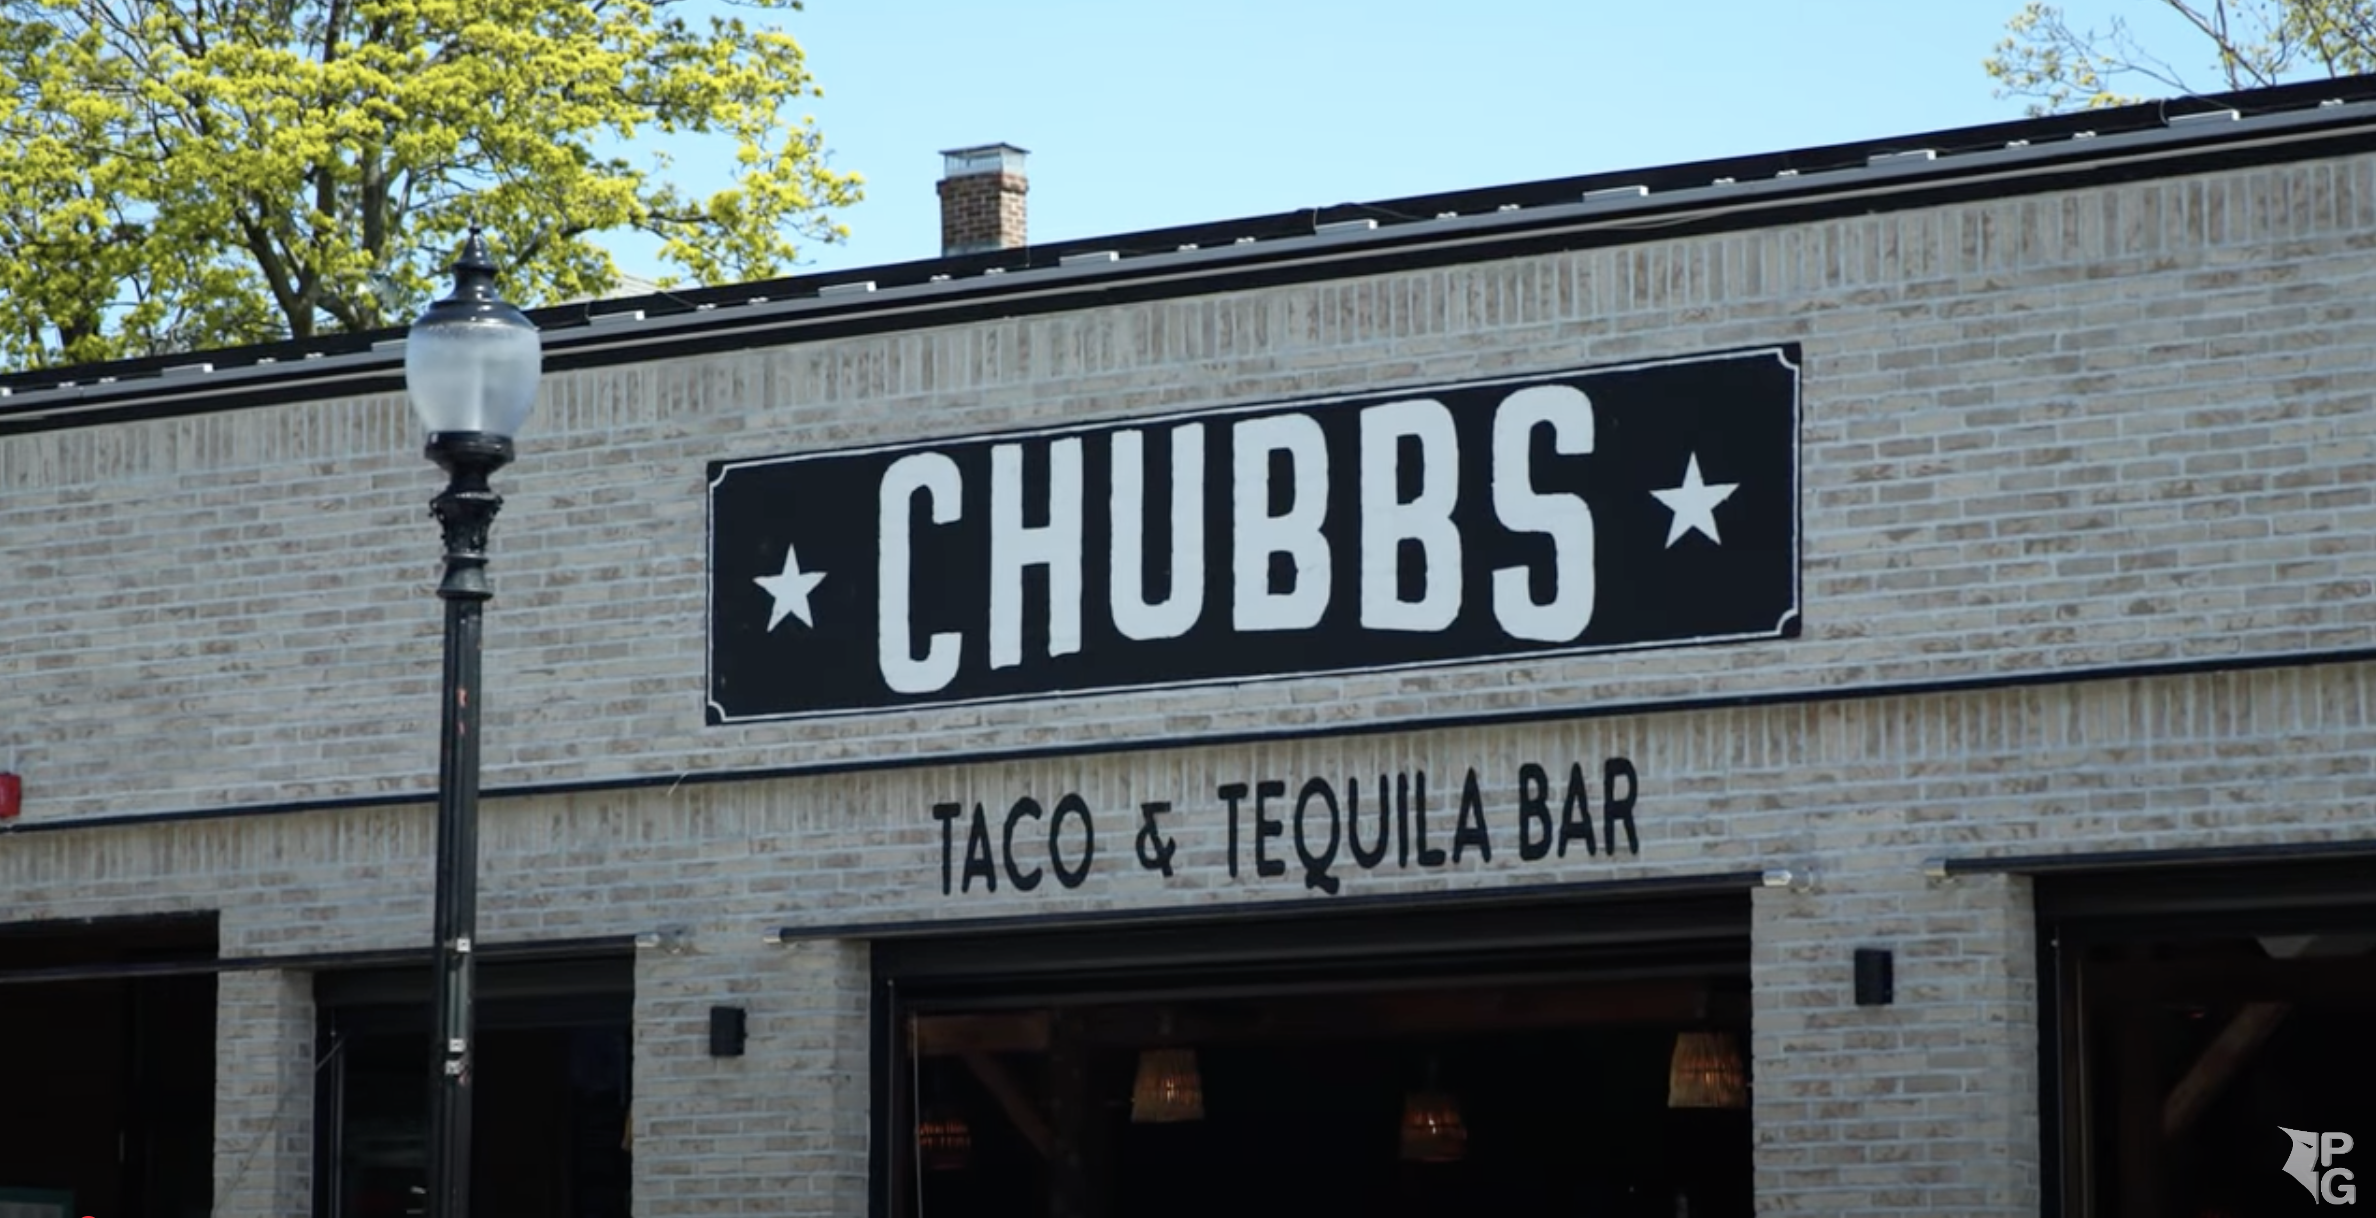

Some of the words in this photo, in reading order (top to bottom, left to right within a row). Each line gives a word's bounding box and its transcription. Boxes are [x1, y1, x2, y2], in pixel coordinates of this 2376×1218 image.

[878, 384, 1596, 694] CHUBBS
[932, 792, 1096, 896] TACO
[1135, 801, 1178, 878] &
[1217, 767, 1492, 896] TEQUILA
[1518, 756, 1640, 863] BAR
